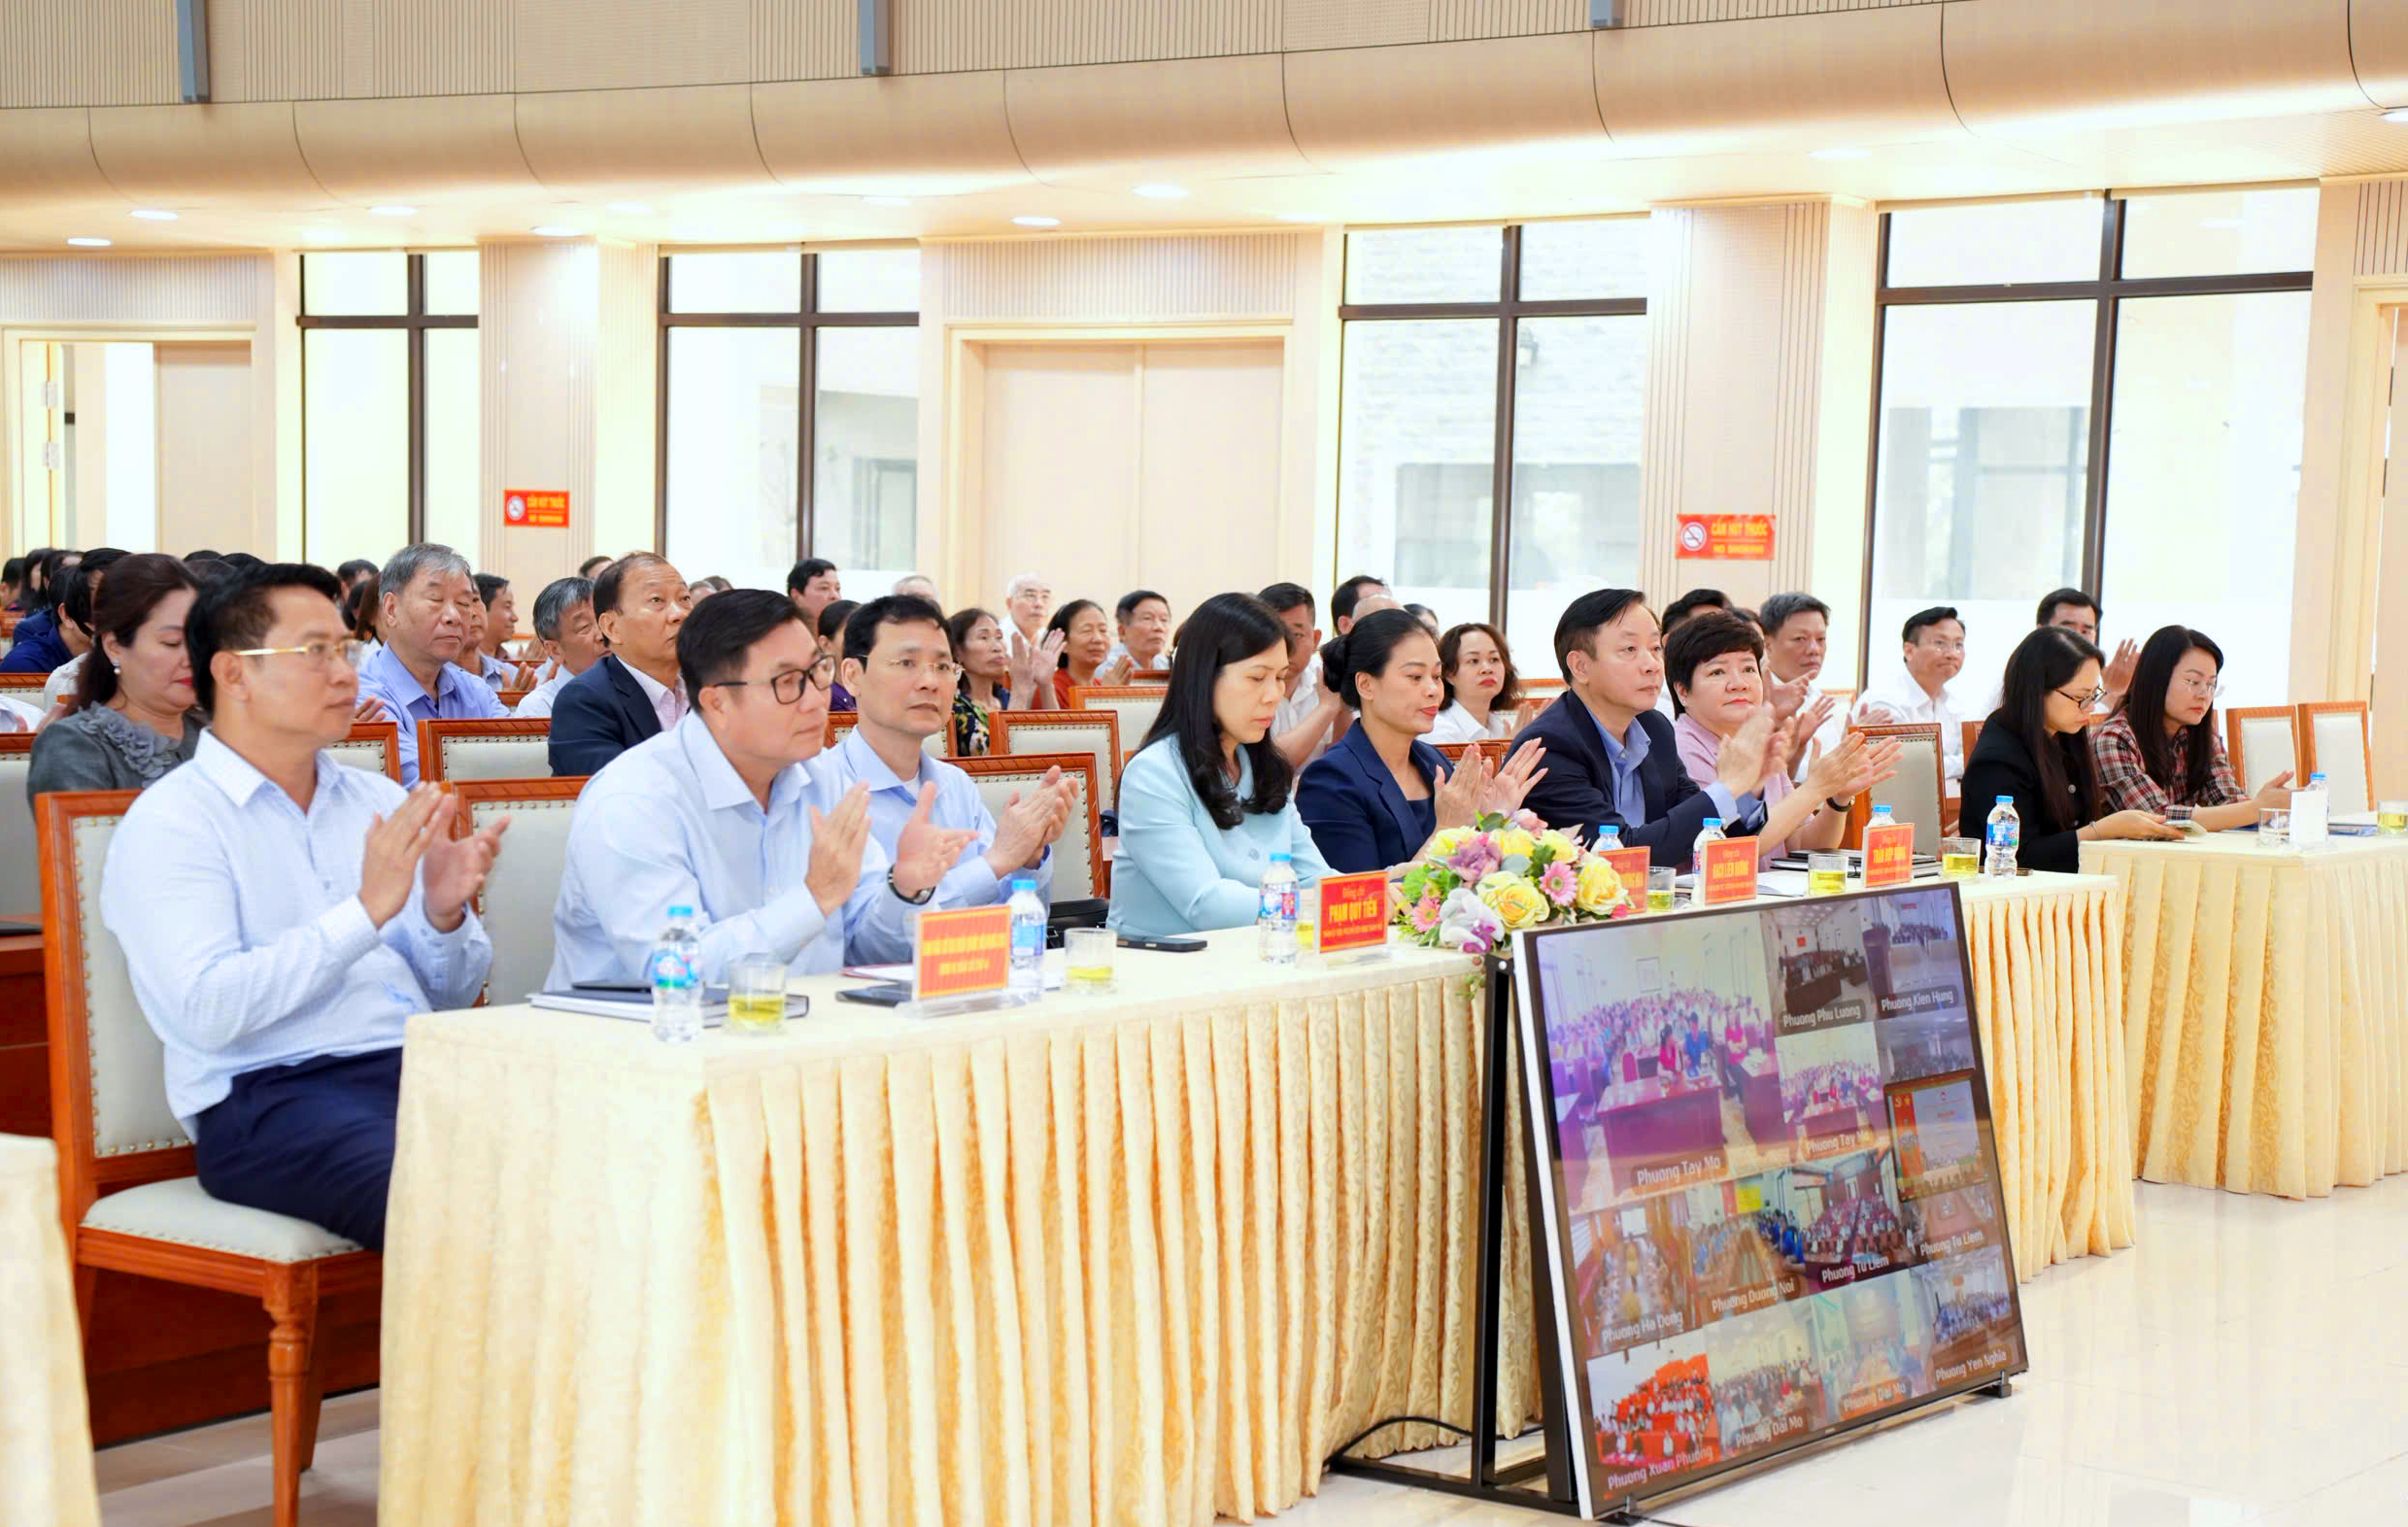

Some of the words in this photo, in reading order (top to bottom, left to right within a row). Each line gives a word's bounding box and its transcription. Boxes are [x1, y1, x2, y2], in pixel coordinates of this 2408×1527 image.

[1882, 997, 1912, 1011] Phuong
[1913, 993, 1931, 1005] Kien
[1932, 991, 1954, 1004] Hung
[1782, 1011, 1815, 1027] Phuong
[1816, 1008, 1834, 1022] Phu
[1835, 1004, 1861, 1019] Luong
[1805, 1137, 1839, 1153] Phuong
[1637, 1167, 1680, 1186] Phuong
[1680, 1161, 1702, 1177] Tay
[1704, 1156, 1721, 1170] Mo
[1919, 1239, 1950, 1256] Phuong
[1821, 1266, 1856, 1282] Phuong
[1856, 1261, 1866, 1273] Tu
[1868, 1256, 1890, 1271] Liem
[1712, 1295, 1747, 1312] Phuong
[1779, 1278, 1795, 1295] Noi
[1603, 1325, 1640, 1343] Phuong
[1935, 1364, 1966, 1381] Phuong
[1967, 1358, 1984, 1372] Yen
[1736, 1426, 1772, 1446] Phuong
[1608, 1469, 1647, 1490] Phuong
[1648, 1460, 1675, 1476] Xuan
[1676, 1446, 1713, 1468] Phuong
